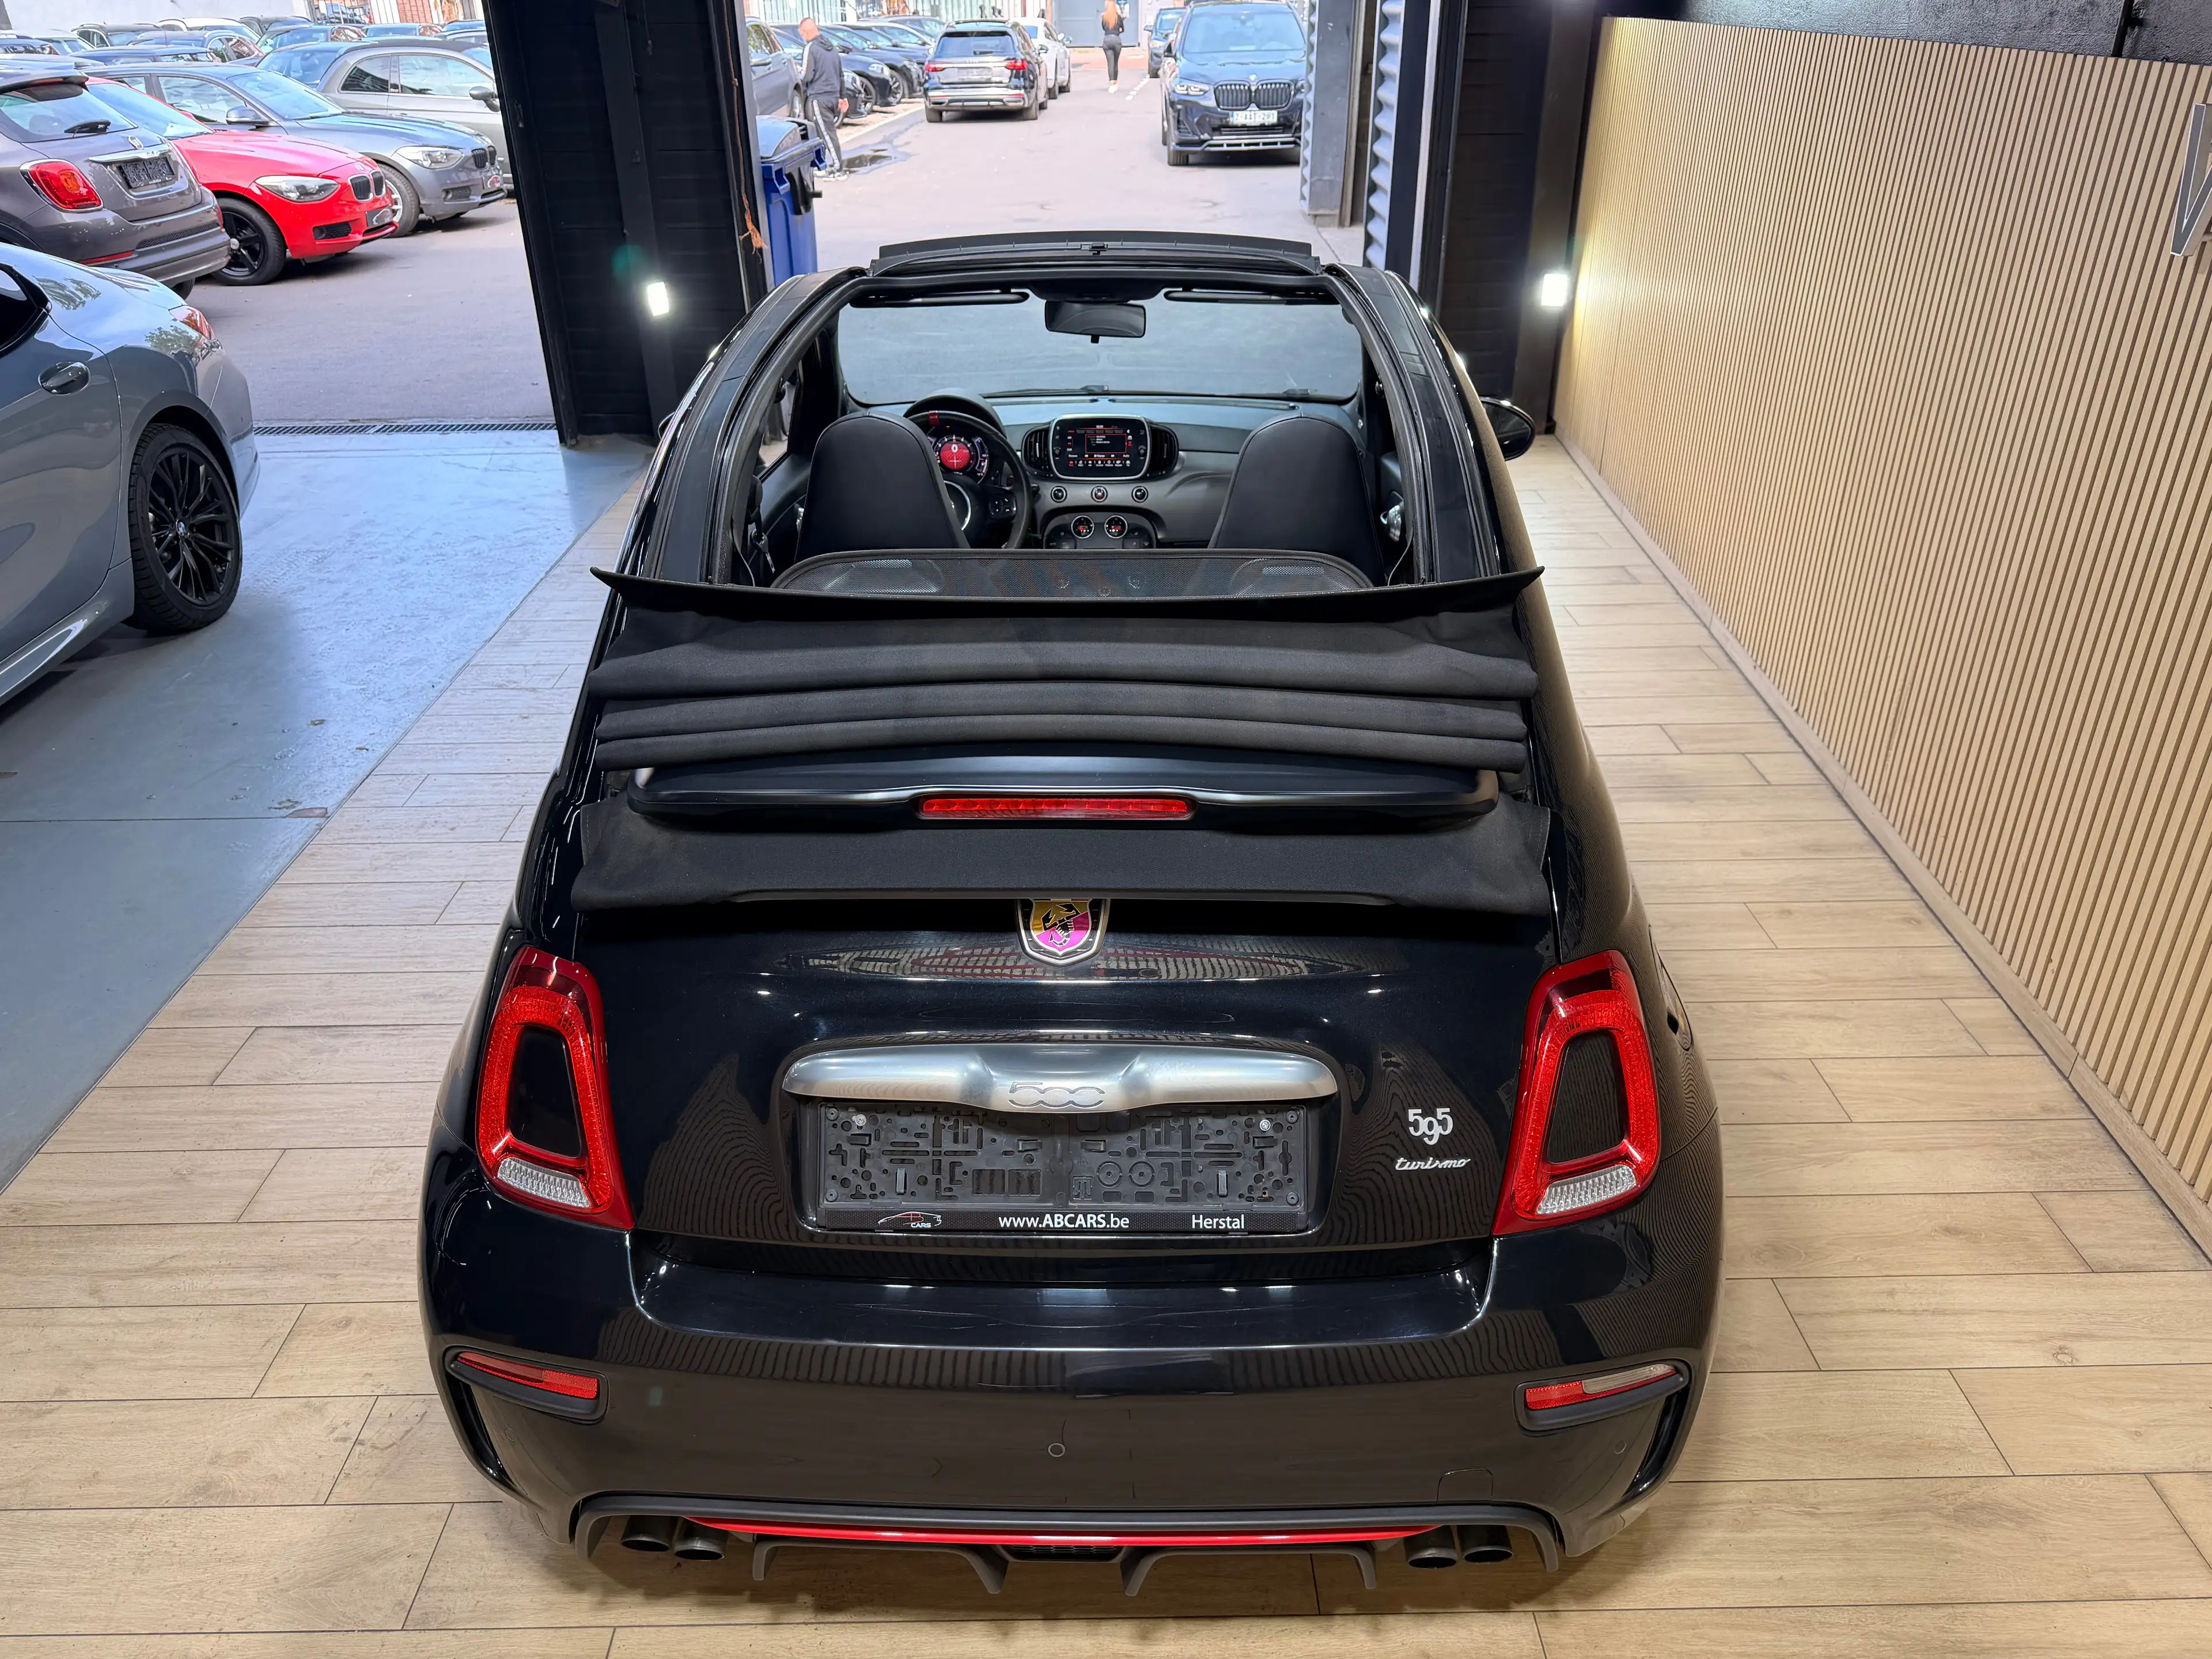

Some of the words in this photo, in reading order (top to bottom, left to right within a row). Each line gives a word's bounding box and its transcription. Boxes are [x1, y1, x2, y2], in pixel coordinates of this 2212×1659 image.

[1008, 1081, 1105, 1108] 500
[1408, 1108, 1453, 1145] 595
[1395, 1157, 1471, 1171] turismo
[998, 1214, 1130, 1228] www.ABCARS.be
[1192, 1214, 1244, 1229] Herstal
